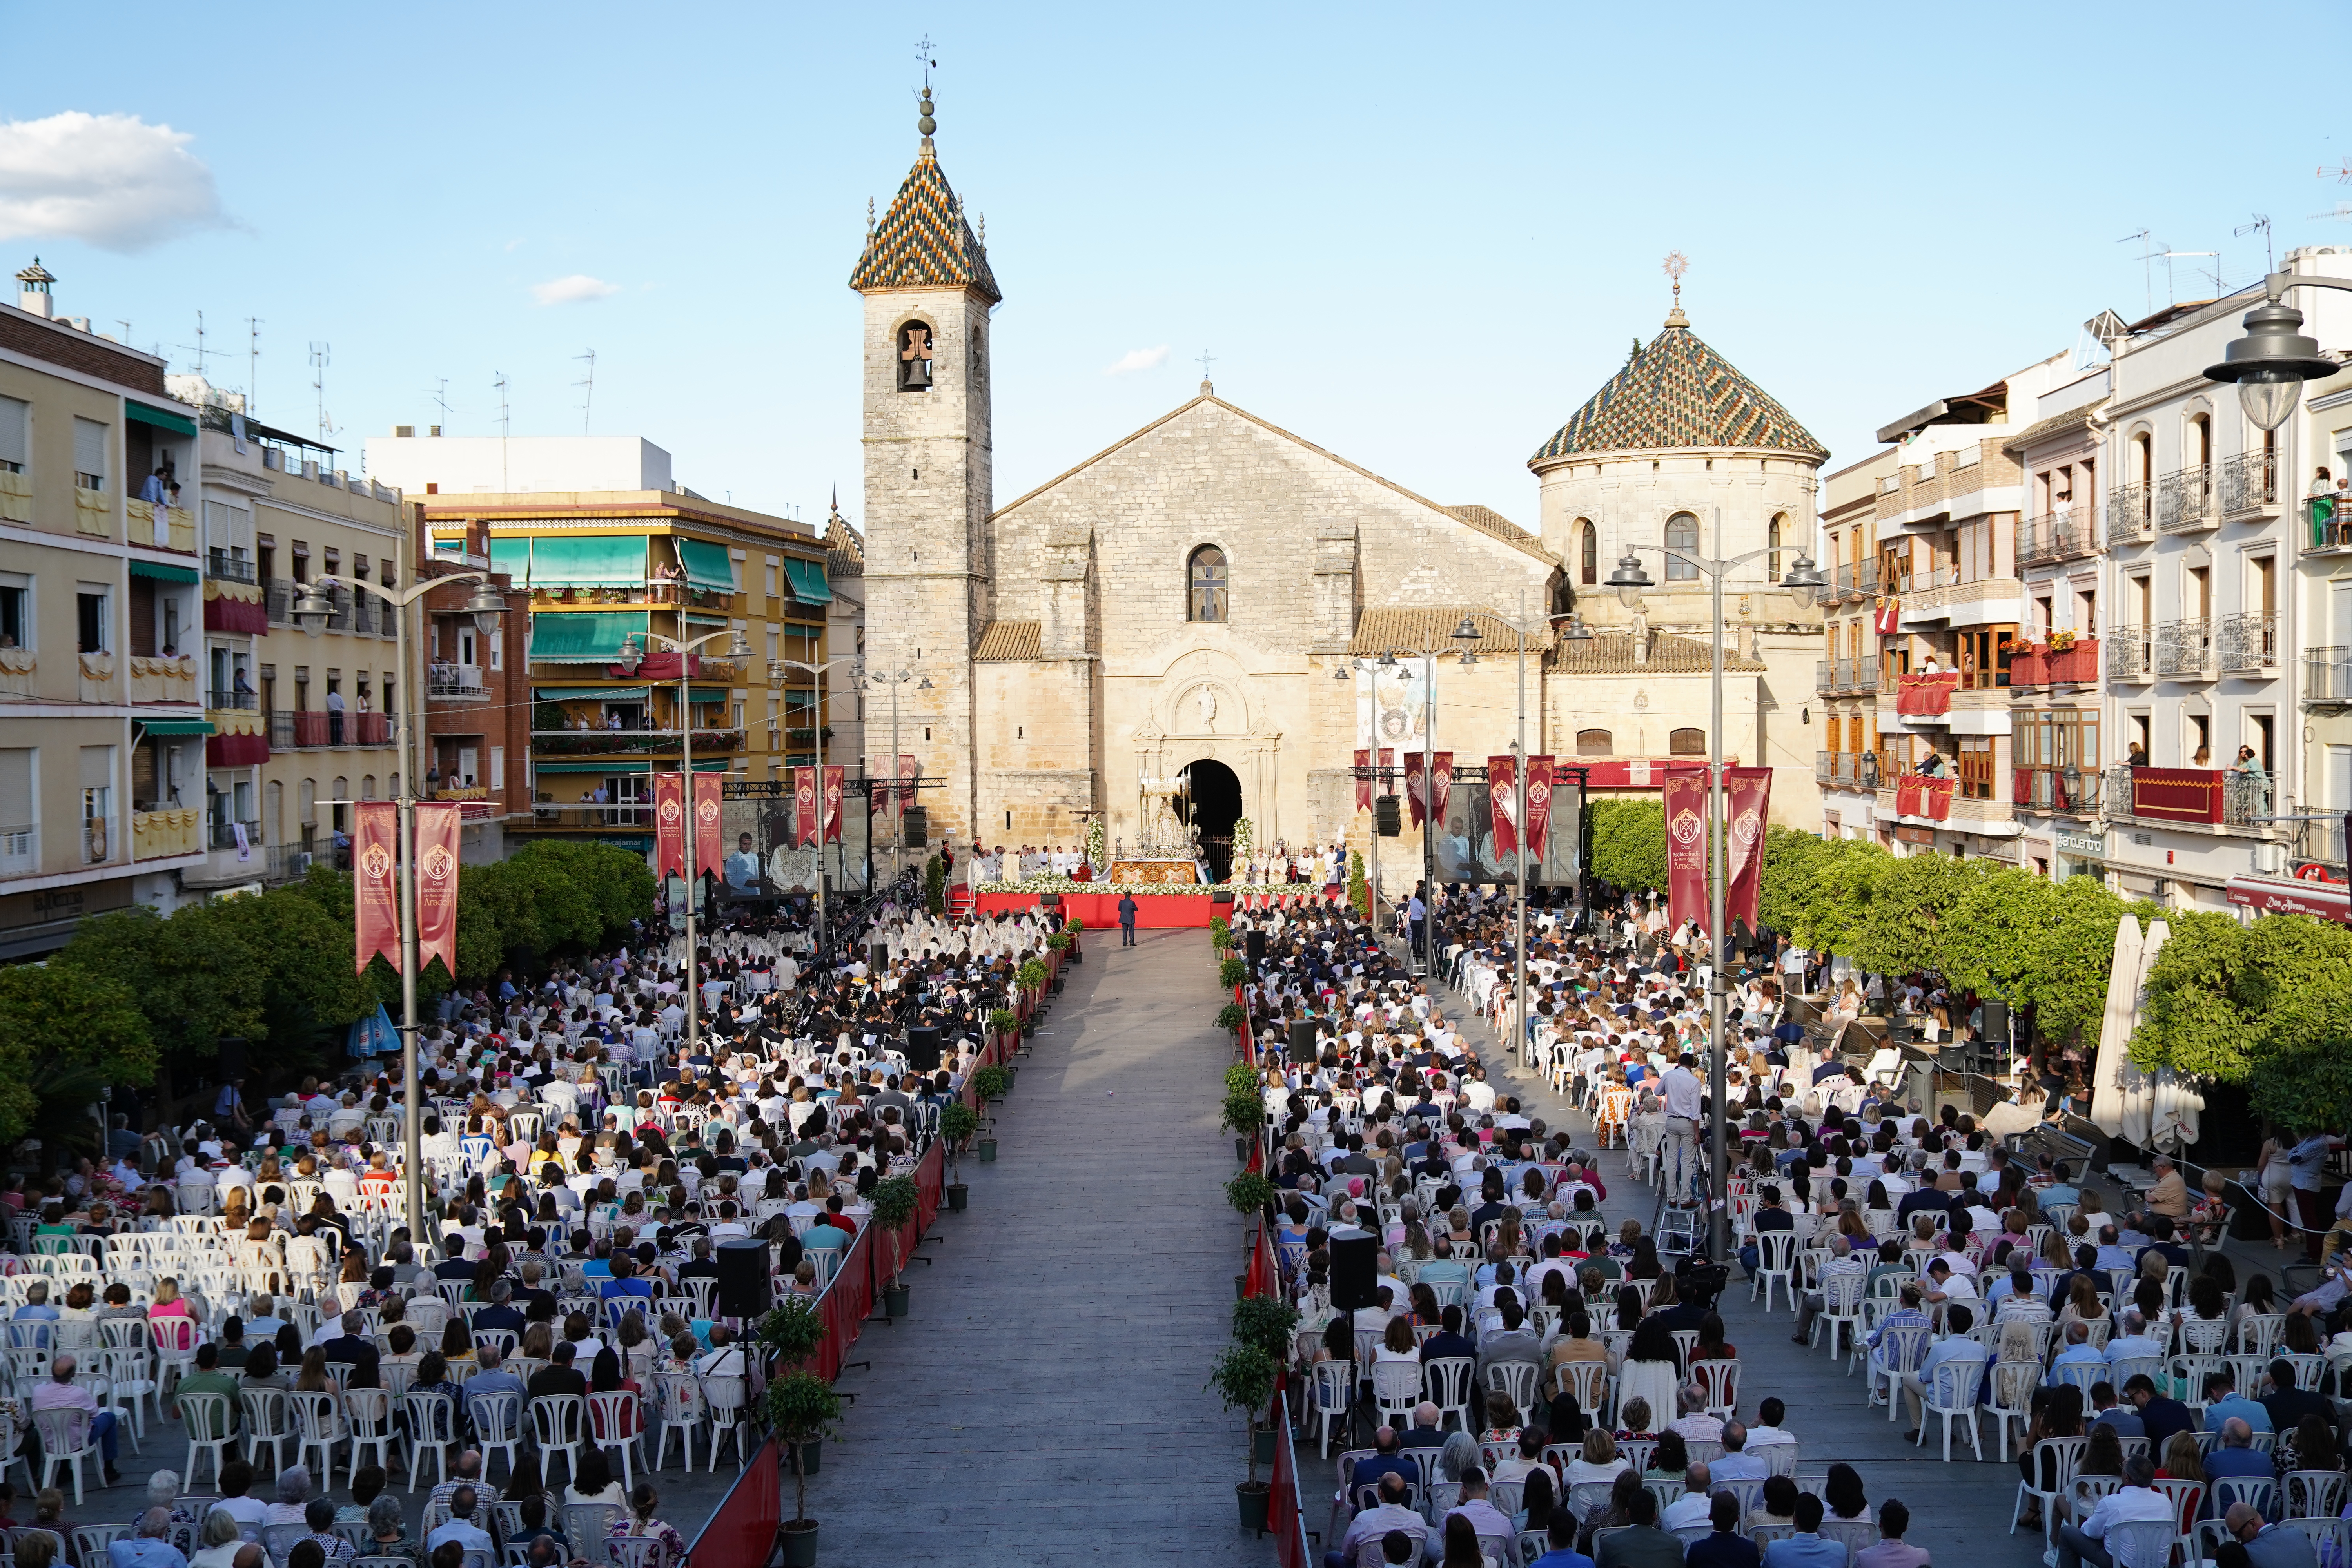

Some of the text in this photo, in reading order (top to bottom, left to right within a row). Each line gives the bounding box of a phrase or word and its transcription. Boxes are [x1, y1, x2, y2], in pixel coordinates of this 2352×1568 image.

[1909, 830, 1919, 840] GAES
[610, 839, 642, 848] cajamar
[2063, 836, 2101, 852] encuentro
[1673, 861, 1701, 870] Araceli
[363, 896, 391, 904] Araceli
[424, 897, 452, 906] Araceli
[2266, 896, 2305, 911] Don Álvaro
